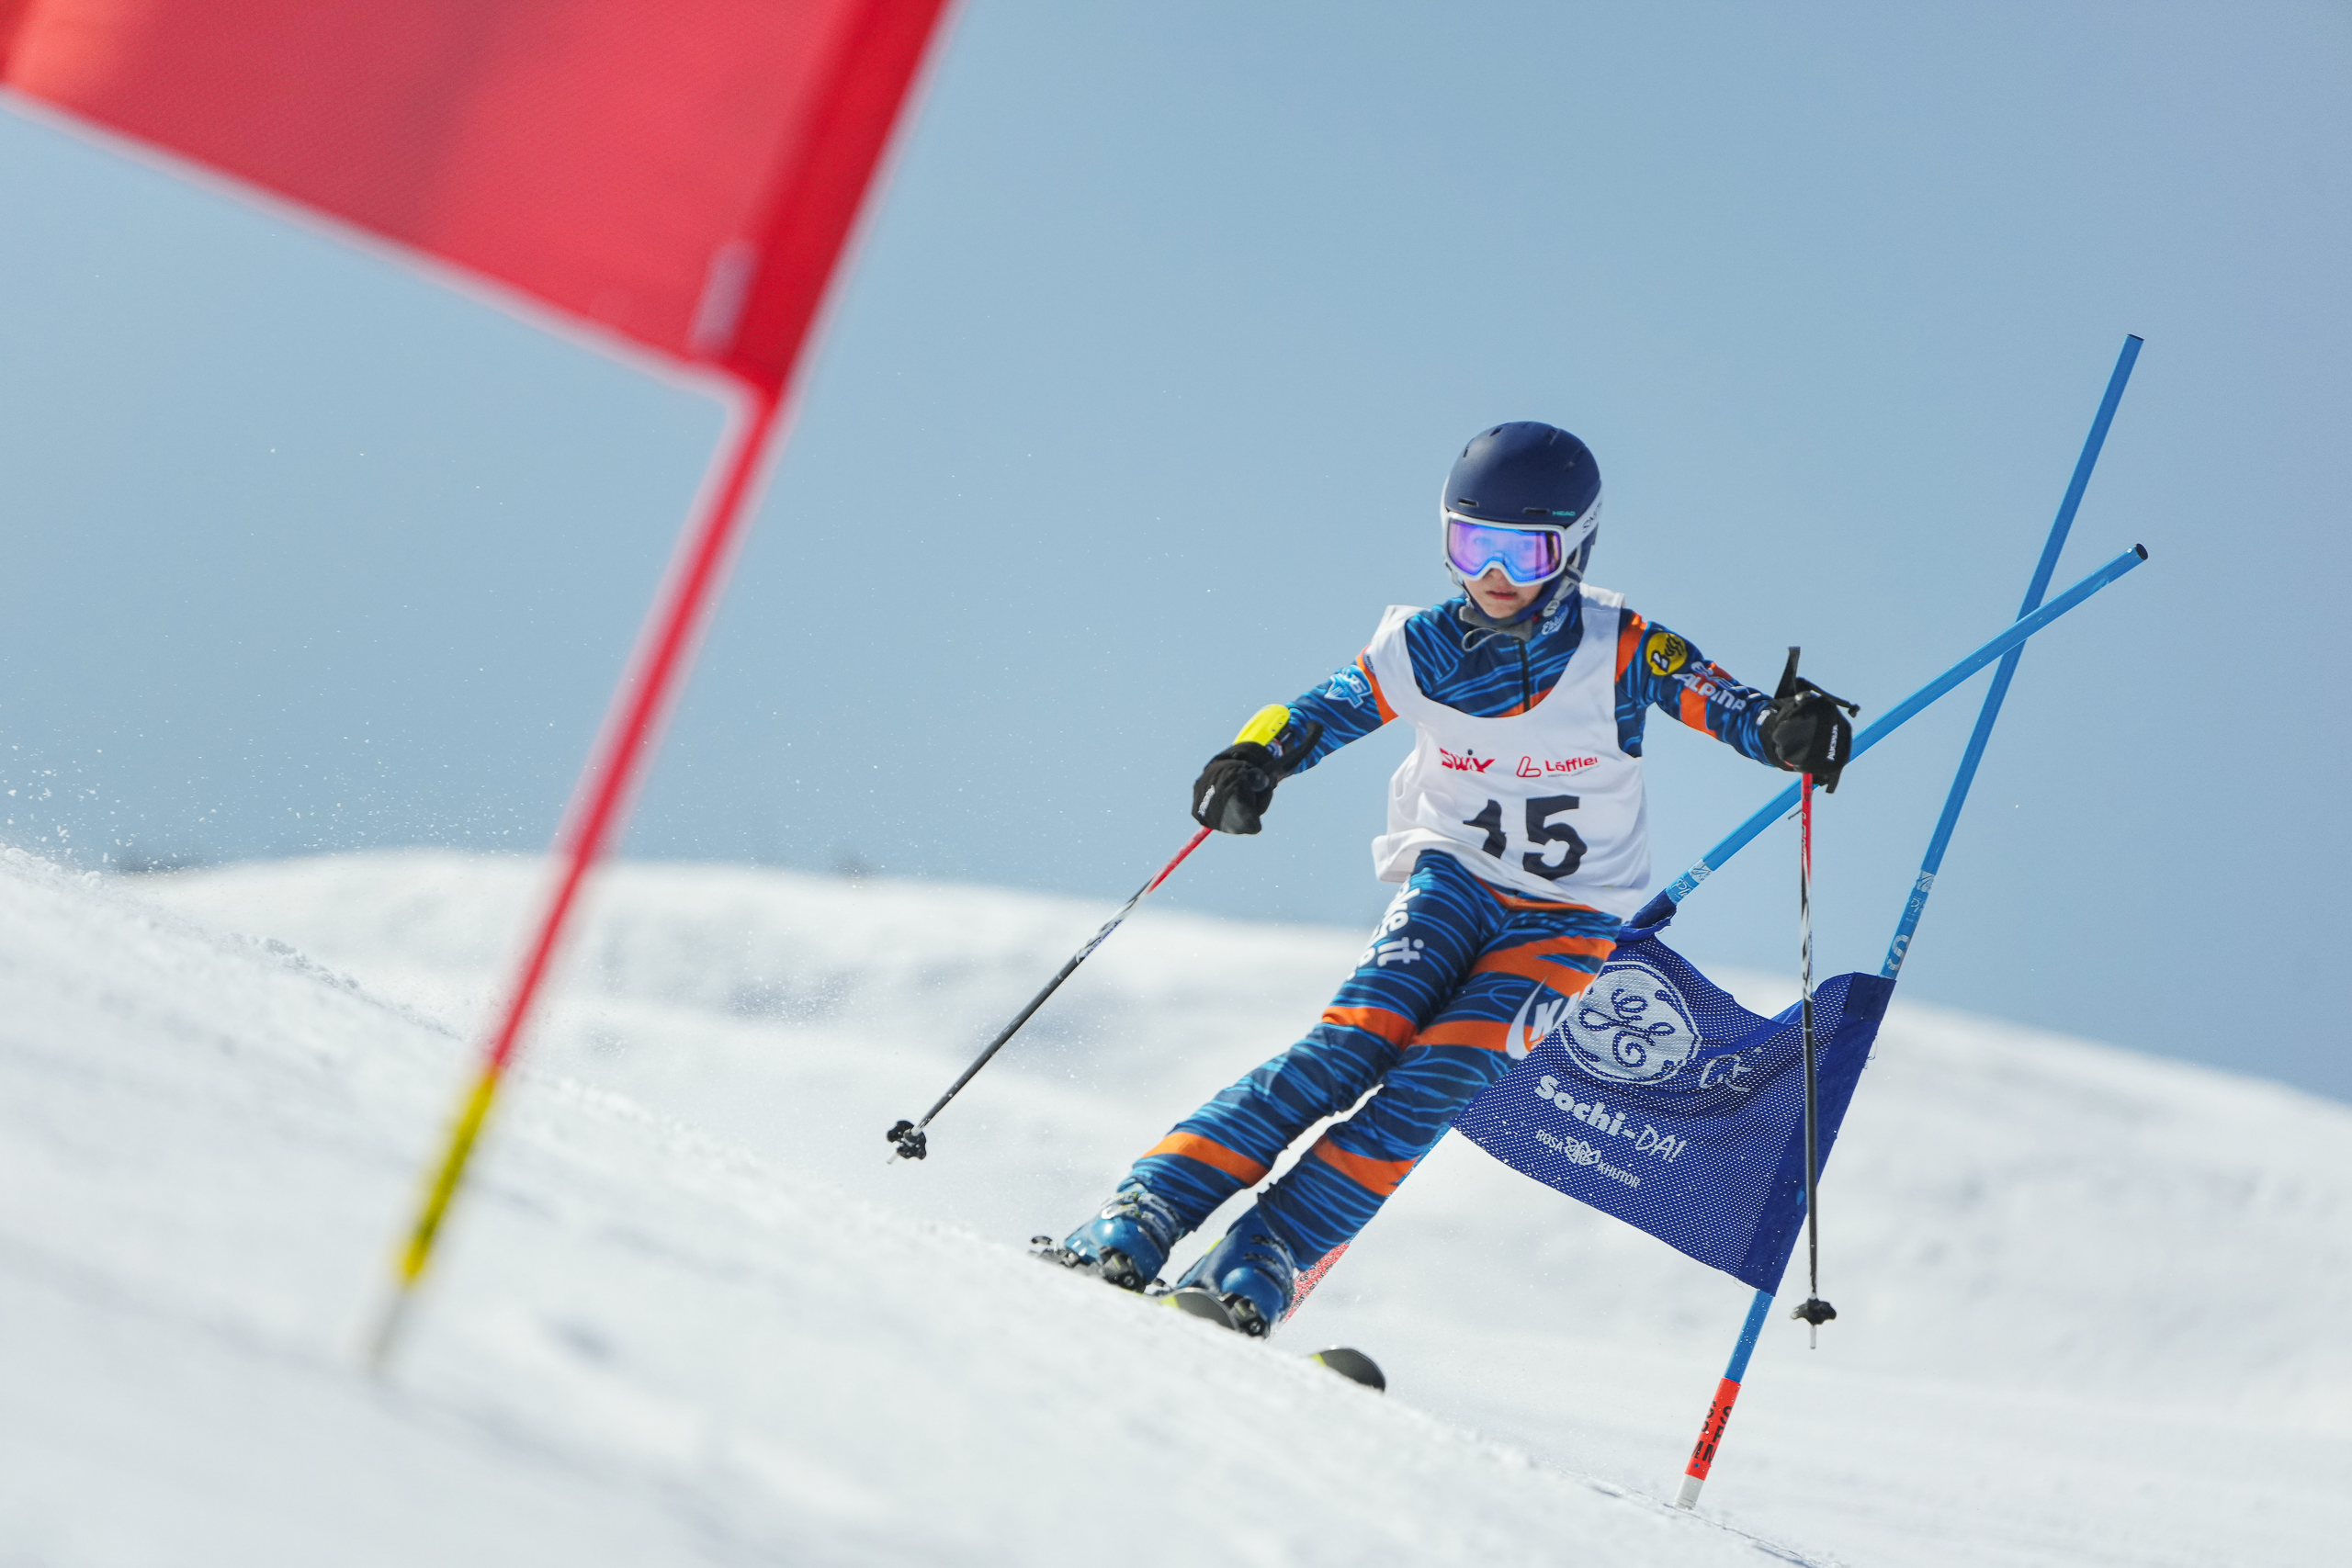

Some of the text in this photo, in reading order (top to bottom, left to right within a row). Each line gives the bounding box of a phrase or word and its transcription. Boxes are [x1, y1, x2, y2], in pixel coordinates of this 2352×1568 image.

[1463, 795, 1588, 881] 15
[1534, 1074, 1687, 1163] Sochi-DA!
[1535, 1129, 1641, 1189] ROSA KHUTOR
